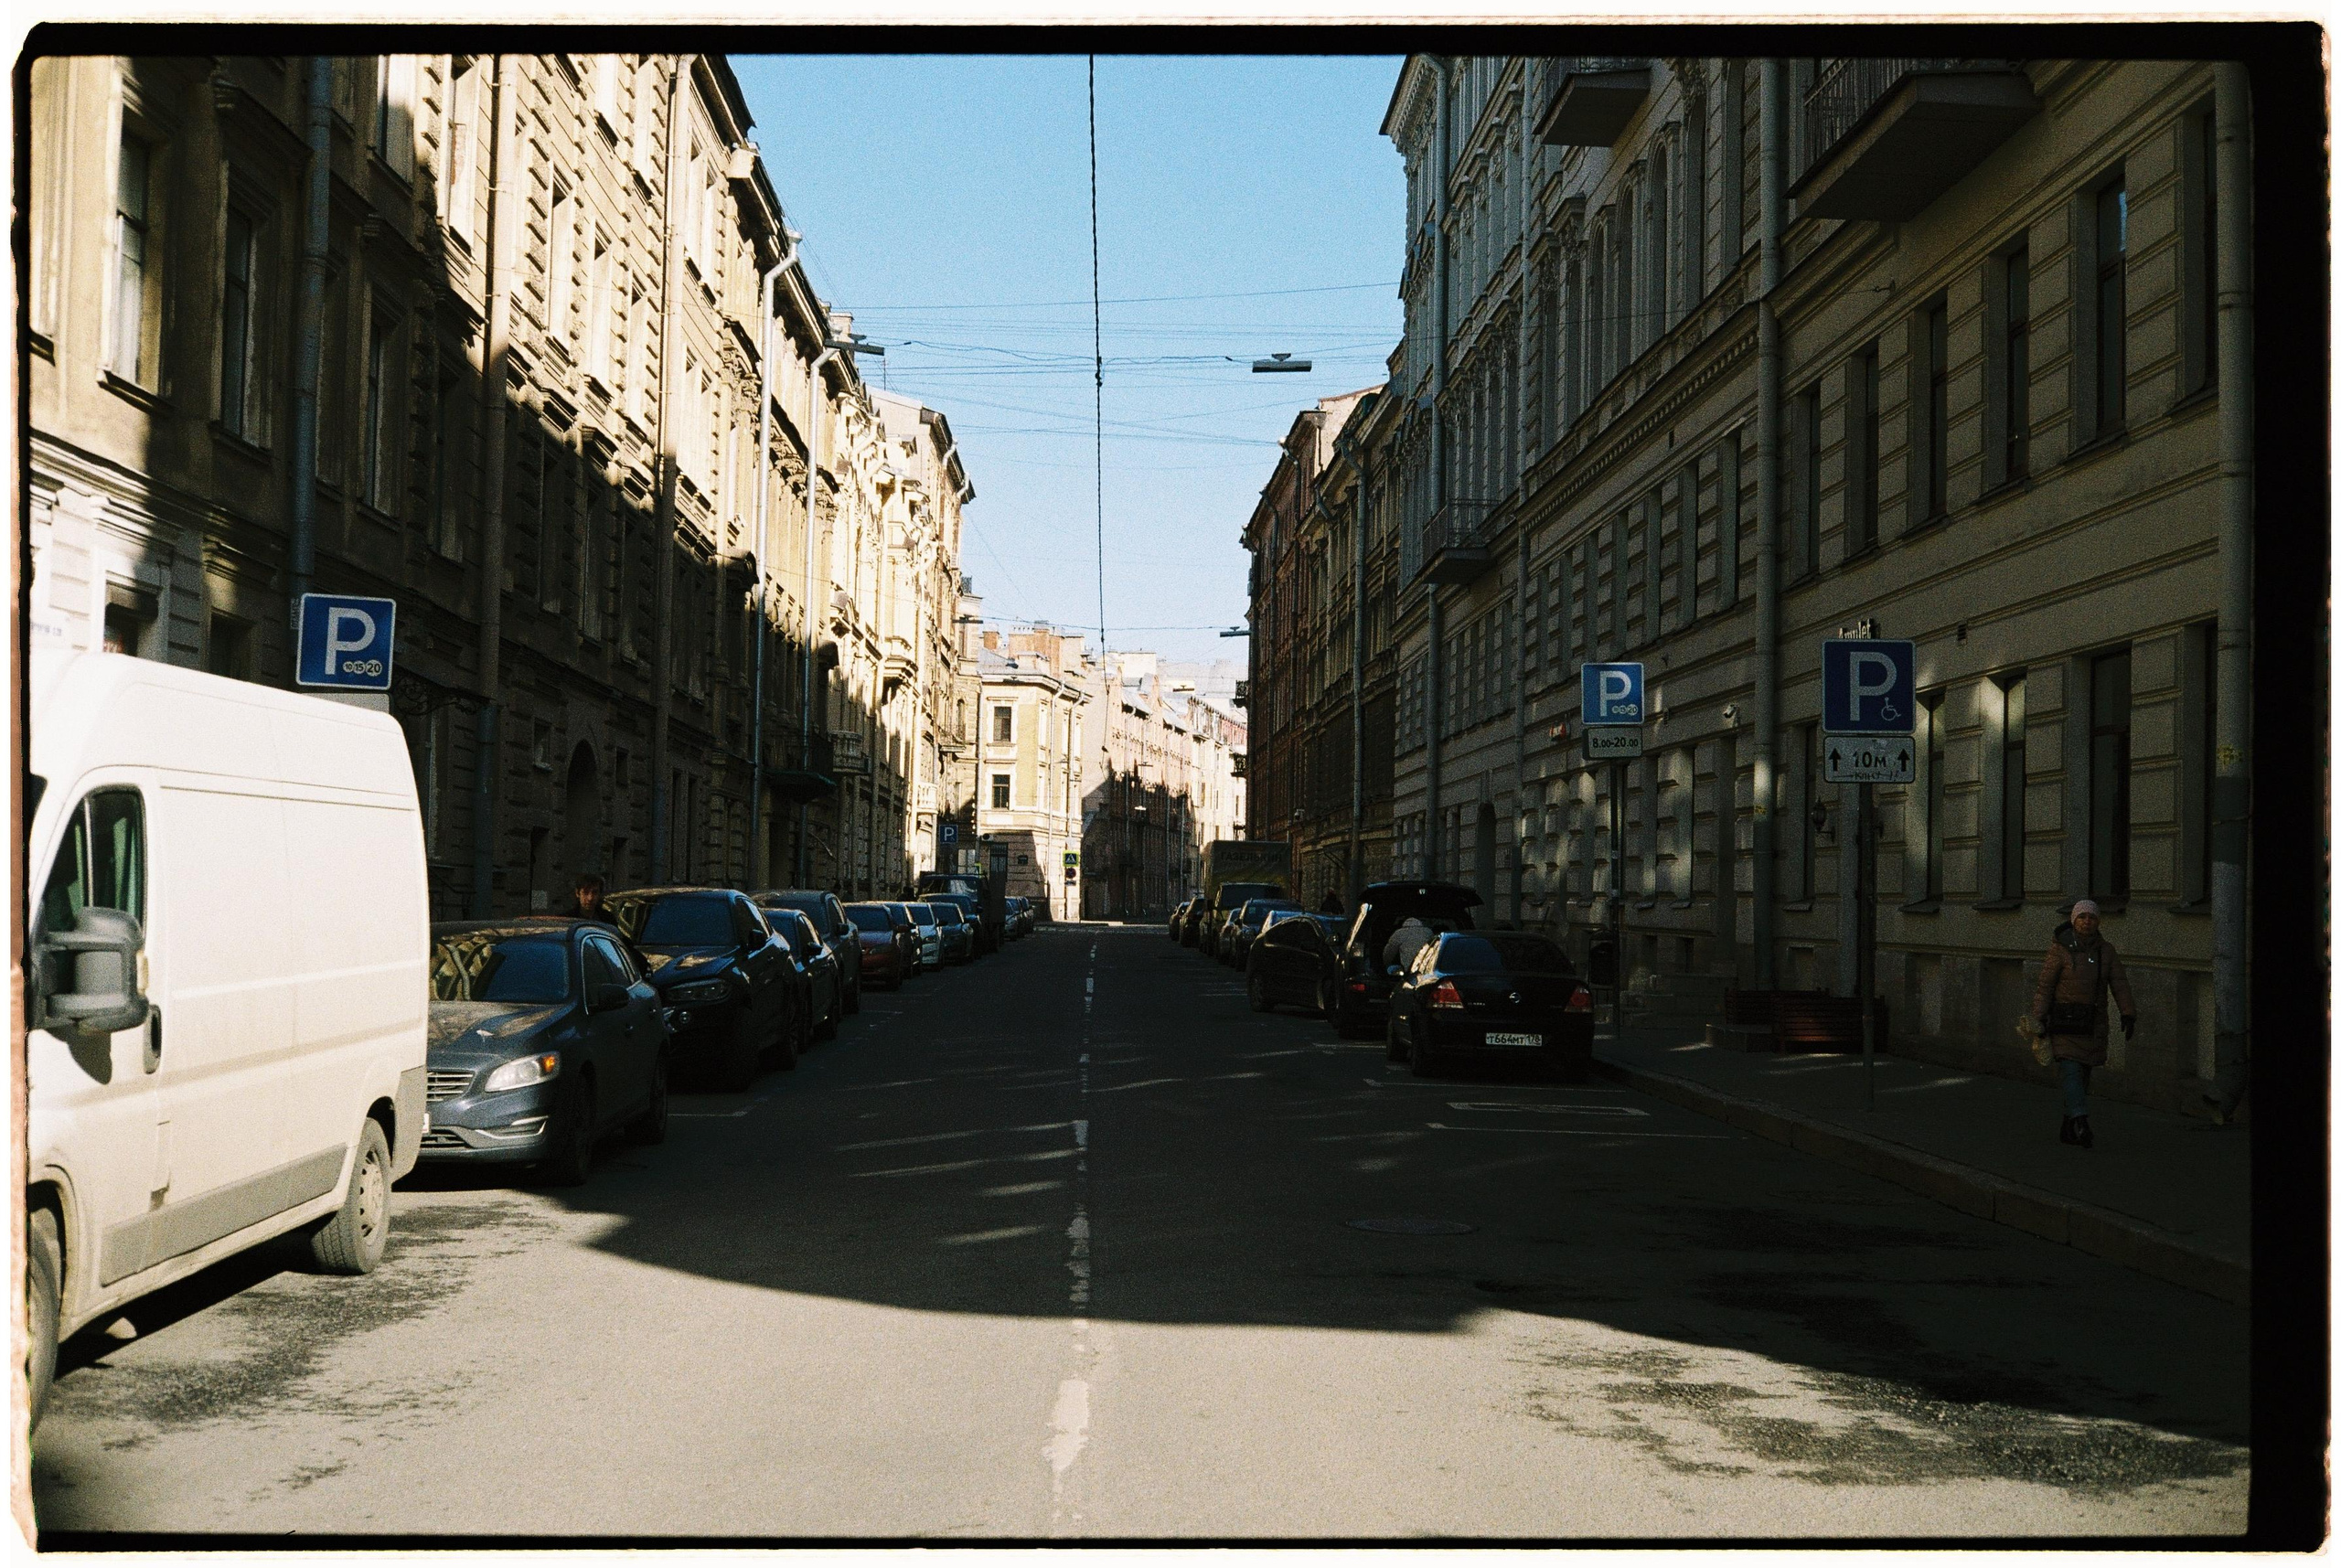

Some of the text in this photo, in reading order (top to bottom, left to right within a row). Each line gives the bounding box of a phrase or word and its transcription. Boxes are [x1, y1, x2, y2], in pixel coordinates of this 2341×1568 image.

[325, 606, 376, 675] P
[355, 663, 364, 672] 15
[367, 663, 381, 673] 20
[1599, 670, 1632, 717] P
[1849, 651, 1897, 721] P
[1592, 737, 1639, 749] 8.00-20.00
[944, 827, 955, 842] P
